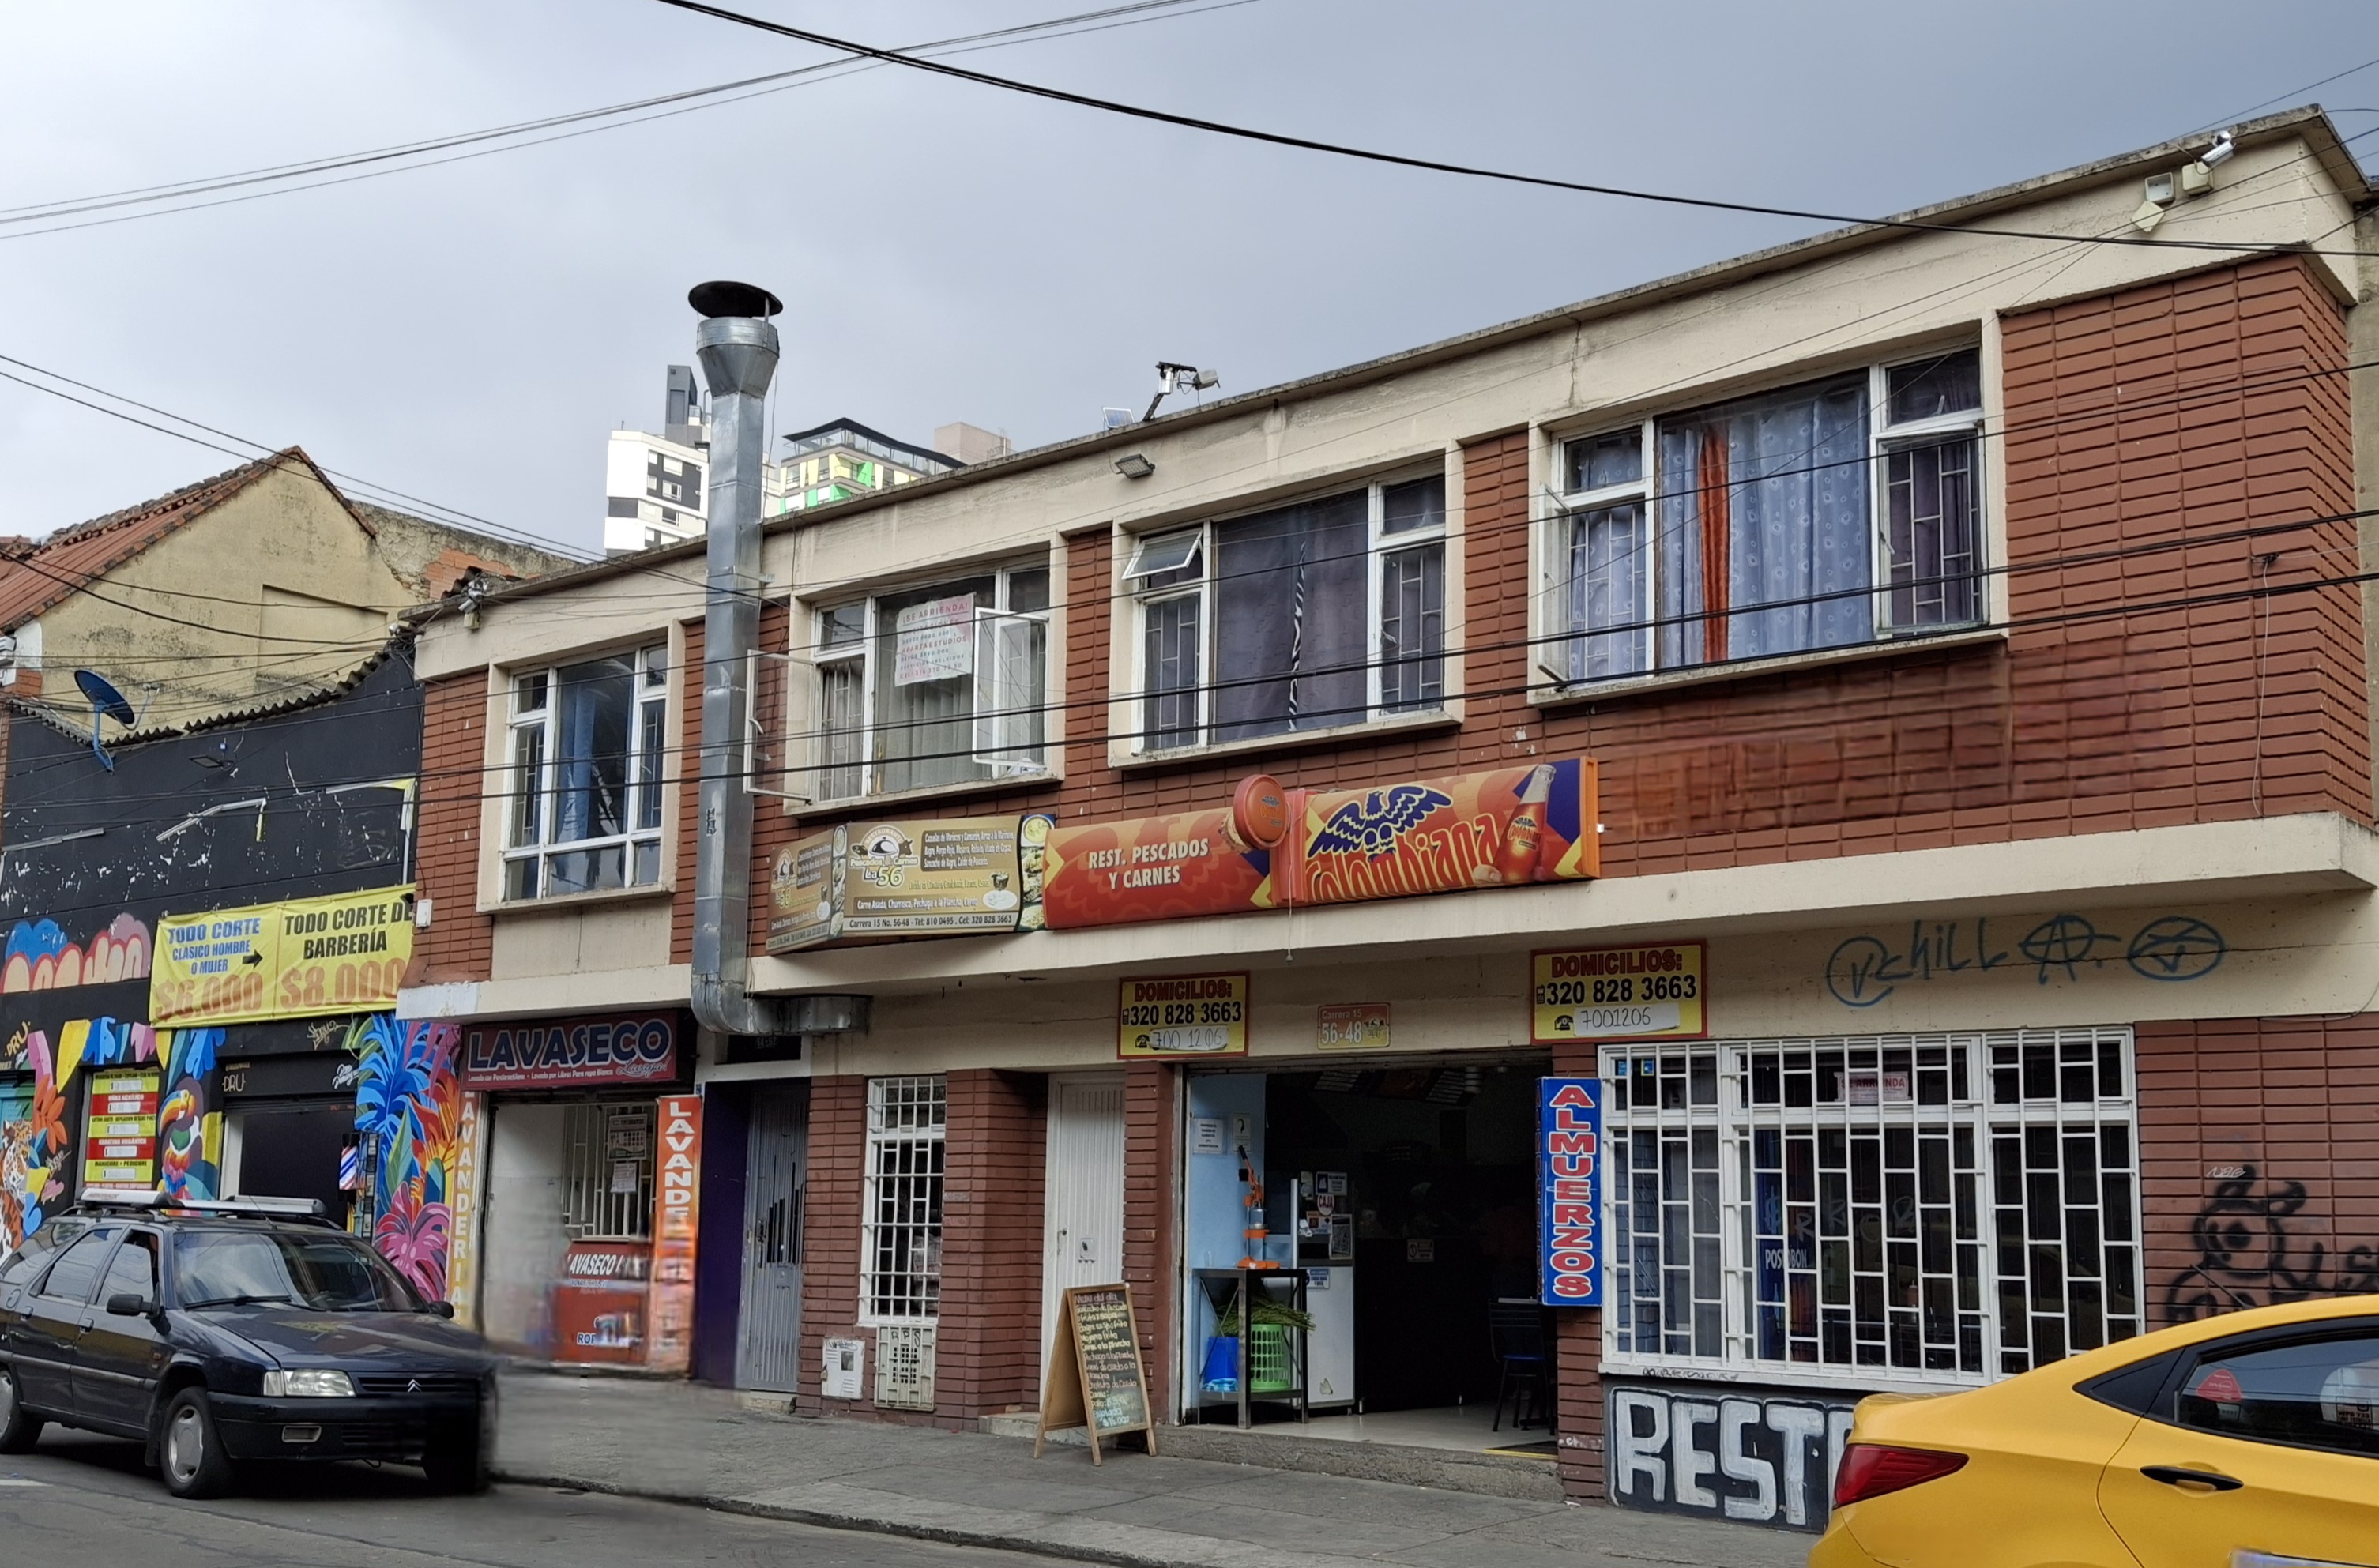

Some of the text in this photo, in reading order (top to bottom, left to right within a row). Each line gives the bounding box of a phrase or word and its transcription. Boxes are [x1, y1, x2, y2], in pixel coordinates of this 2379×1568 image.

[919, 602, 968, 619] ARRIENDA!
[1088, 837, 1210, 870] REST. PESCADOS
[864, 868, 878, 881] La
[876, 866, 904, 887] 56
[1108, 866, 1181, 891] Y CARNES
[168, 917, 262, 945] TODO CORTE
[284, 912, 329, 935] TODO
[332, 903, 387, 931] CORTE
[849, 919, 871, 928] Carrera
[882, 919, 892, 927] No.
[893, 917, 909, 927] 56-48
[926, 916, 937, 925] 810
[971, 916, 983, 924] 320
[984, 915, 996, 923] 828
[997, 915, 1012, 923] 3663
[172, 939, 250, 961] CLÁSICO HOMBRE
[303, 927, 388, 961] BARBERÍA
[190, 958, 228, 975] O MUJER
[1551, 949, 1683, 978] DOMICILIOS:
[280, 957, 407, 1010] $8.000
[1135, 979, 1233, 1002] DOMICILIOS:
[1546, 974, 1696, 1006] 320 828 3663
[1130, 1000, 1242, 1026] 320 828 3663
[1322, 1008, 1362, 1020] Carrera 15
[1580, 1006, 1651, 1030] 7001206
[468, 1018, 672, 1072] LAVASECO
[1152, 1028, 1222, 1049] 700 1206
[1856, 1077, 1905, 1088] ARRINDA
[1319, 1194, 1334, 1209] CAJA
[1549, 1085, 1596, 1298] ALMUERZOS
[567, 1254, 617, 1276] AVASECO
